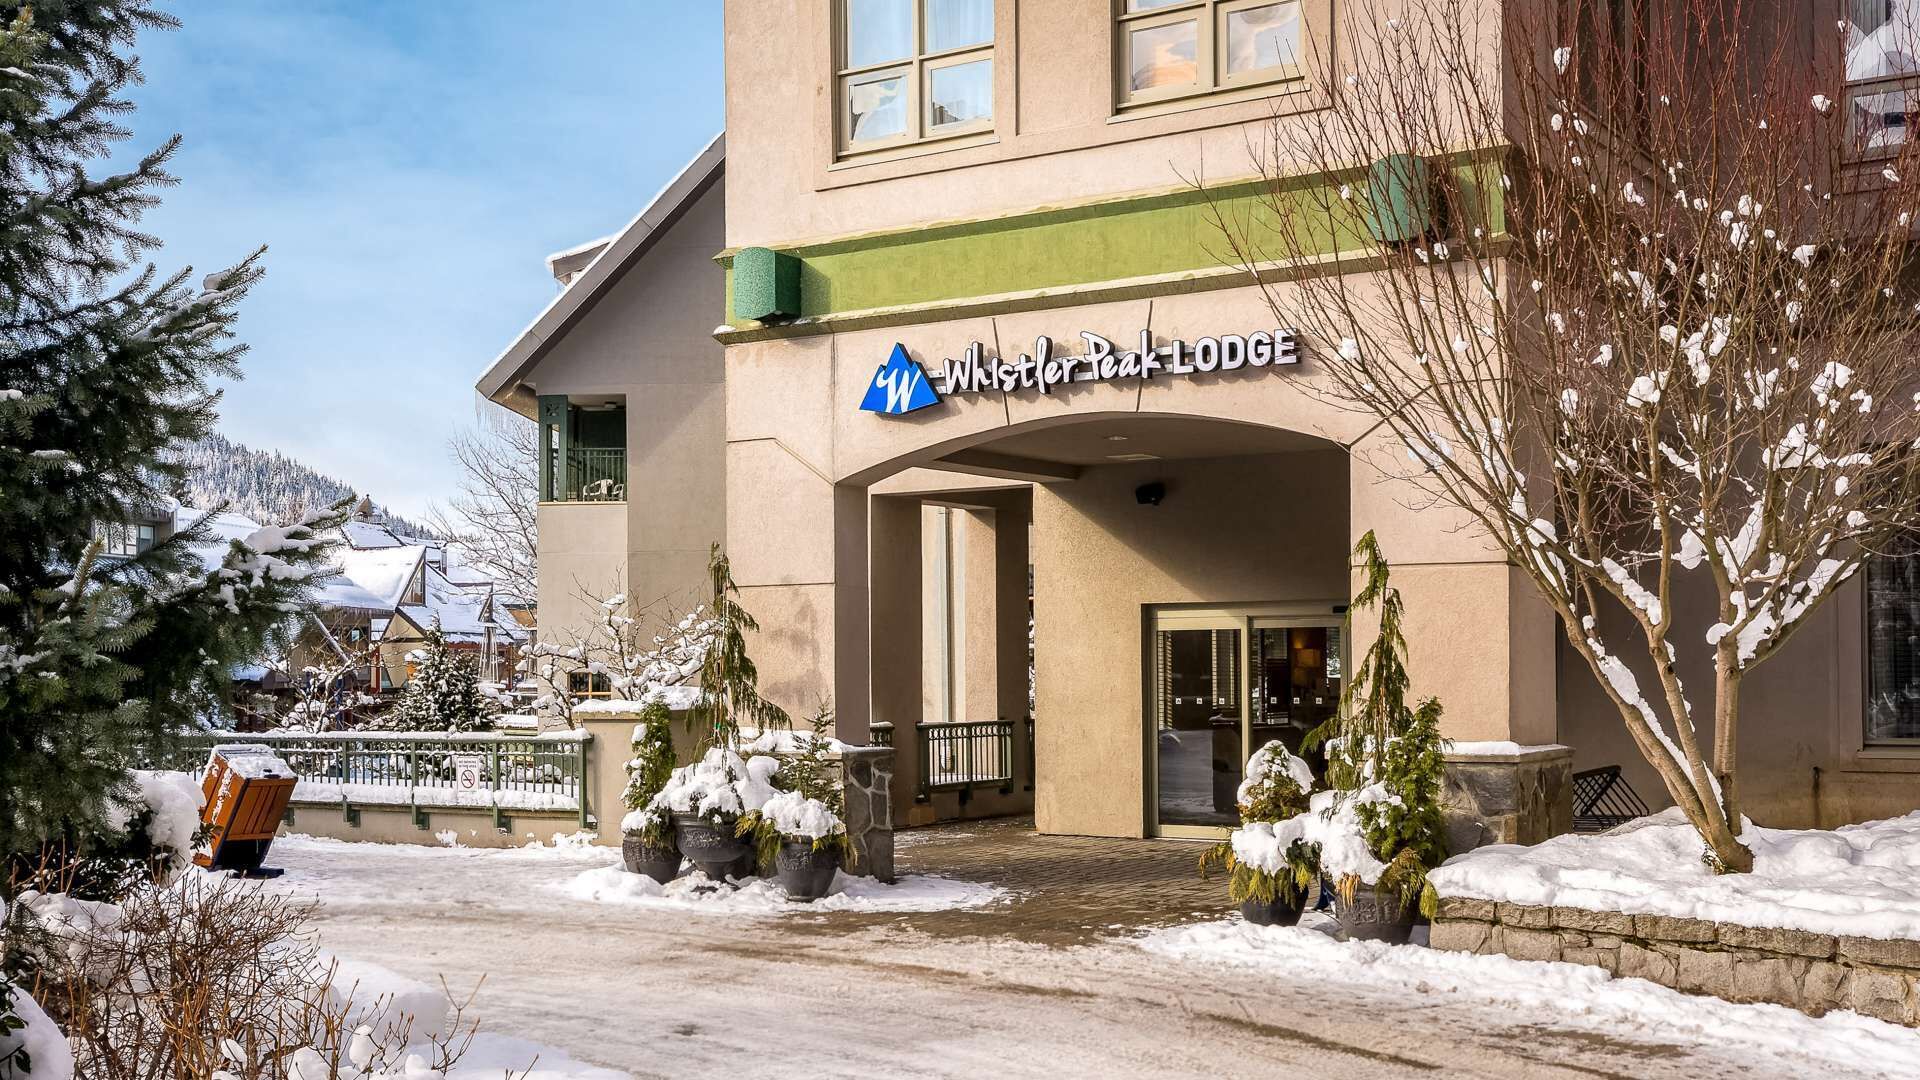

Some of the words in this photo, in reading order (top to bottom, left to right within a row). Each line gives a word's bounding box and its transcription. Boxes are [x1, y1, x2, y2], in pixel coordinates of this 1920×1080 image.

[943, 335, 1079, 395] Whistler
[1080, 330, 1161, 380] Peak
[1171, 328, 1298, 375] LODGE
[876, 367, 920, 413] W
